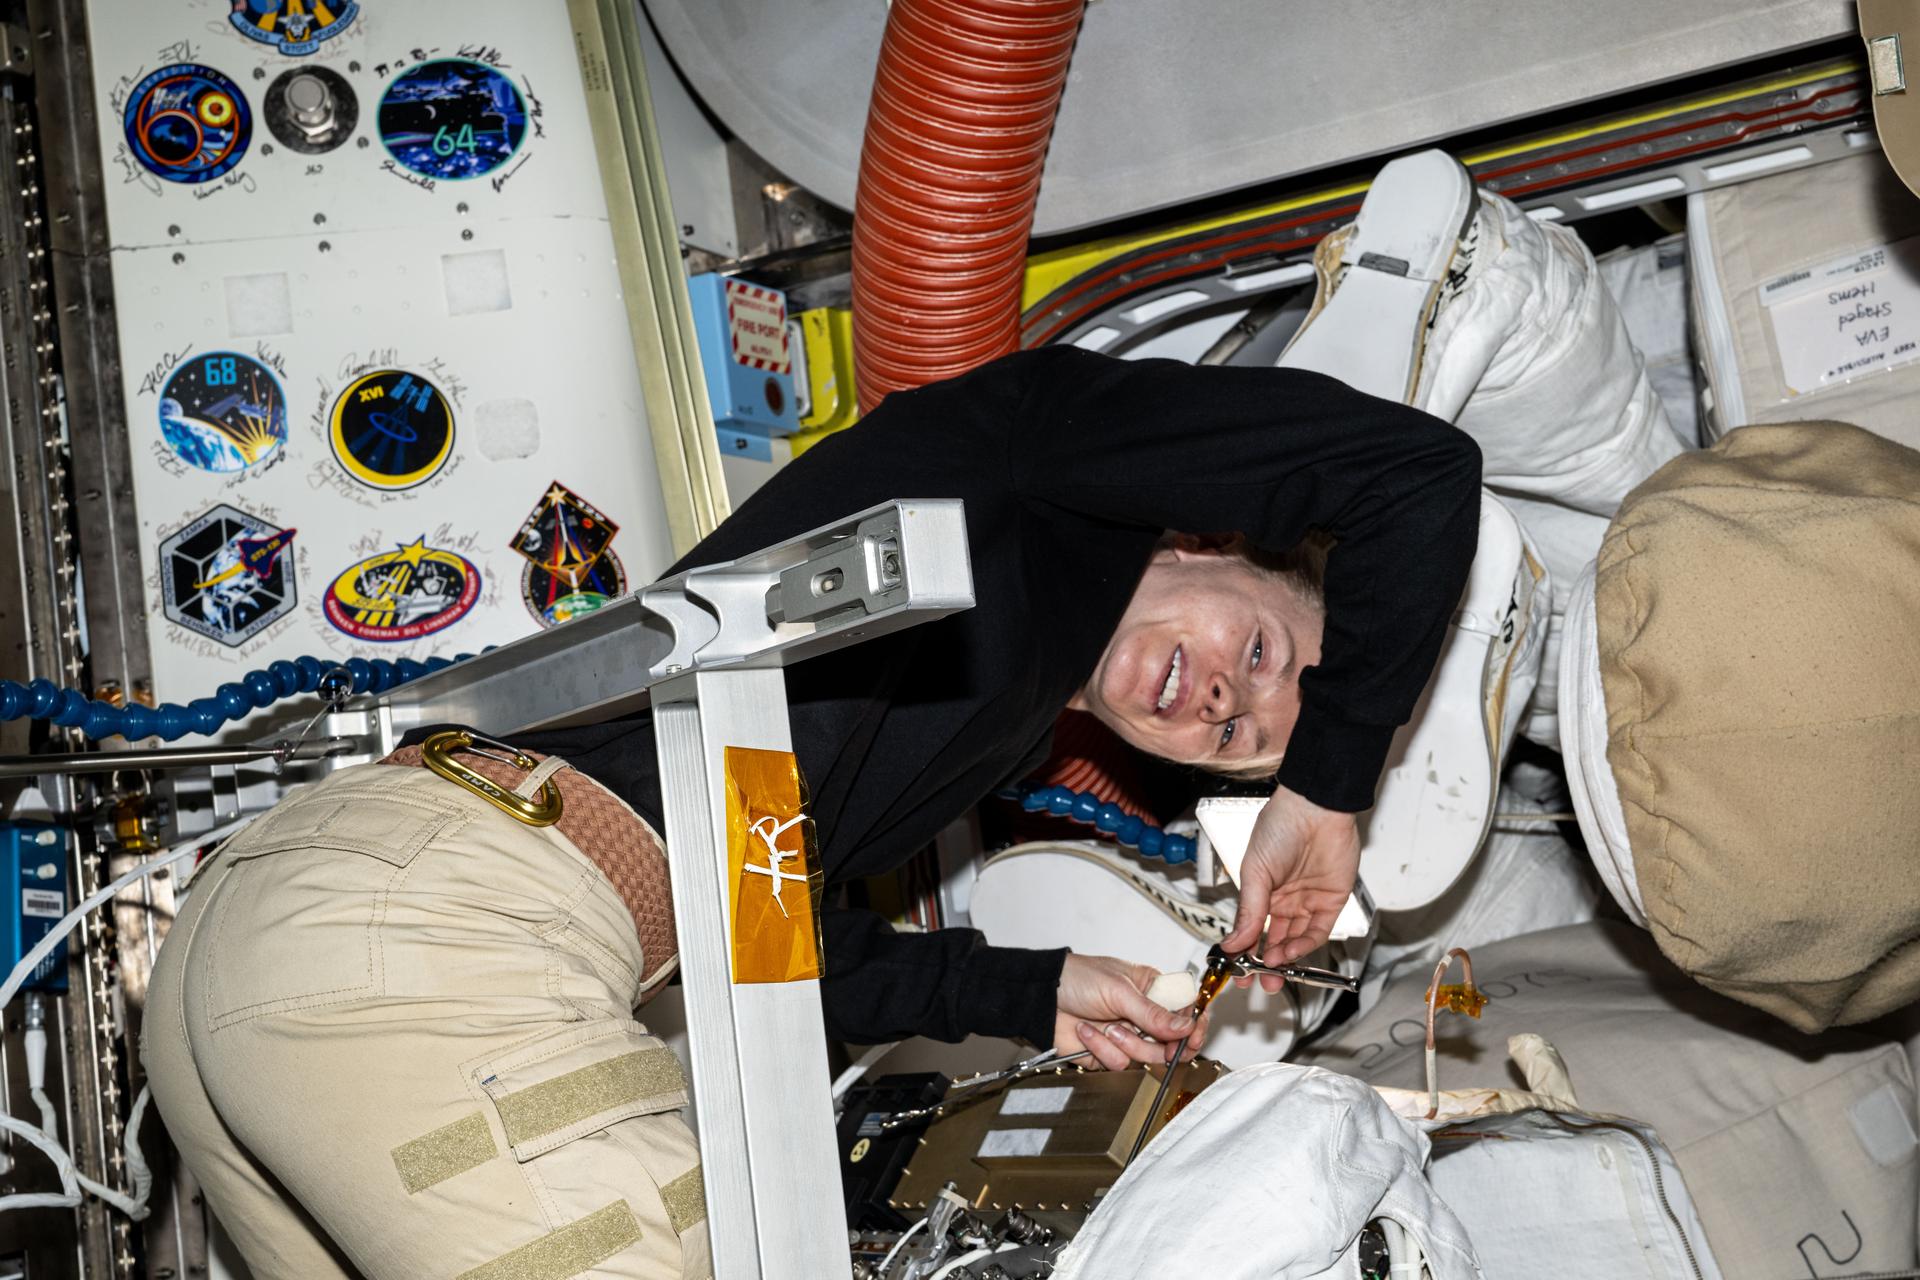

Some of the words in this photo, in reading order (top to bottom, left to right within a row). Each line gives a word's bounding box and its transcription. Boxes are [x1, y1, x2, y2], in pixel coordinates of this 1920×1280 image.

[432, 124, 477, 156] 64
[737, 318, 757, 334] FIRE
[757, 322, 780, 338] PORT
[1838, 302, 1892, 331] Staged
[1855, 326, 1889, 346] EVA
[205, 358, 237, 386] 68
[358, 385, 385, 403] XVI
[180, 518, 210, 541] ZAMKA
[180, 616, 225, 640] BEHNKEN
[244, 609, 281, 636] PATRICK
[358, 626, 400, 637] FOREMAN
[462, 773, 501, 797] CAMP
